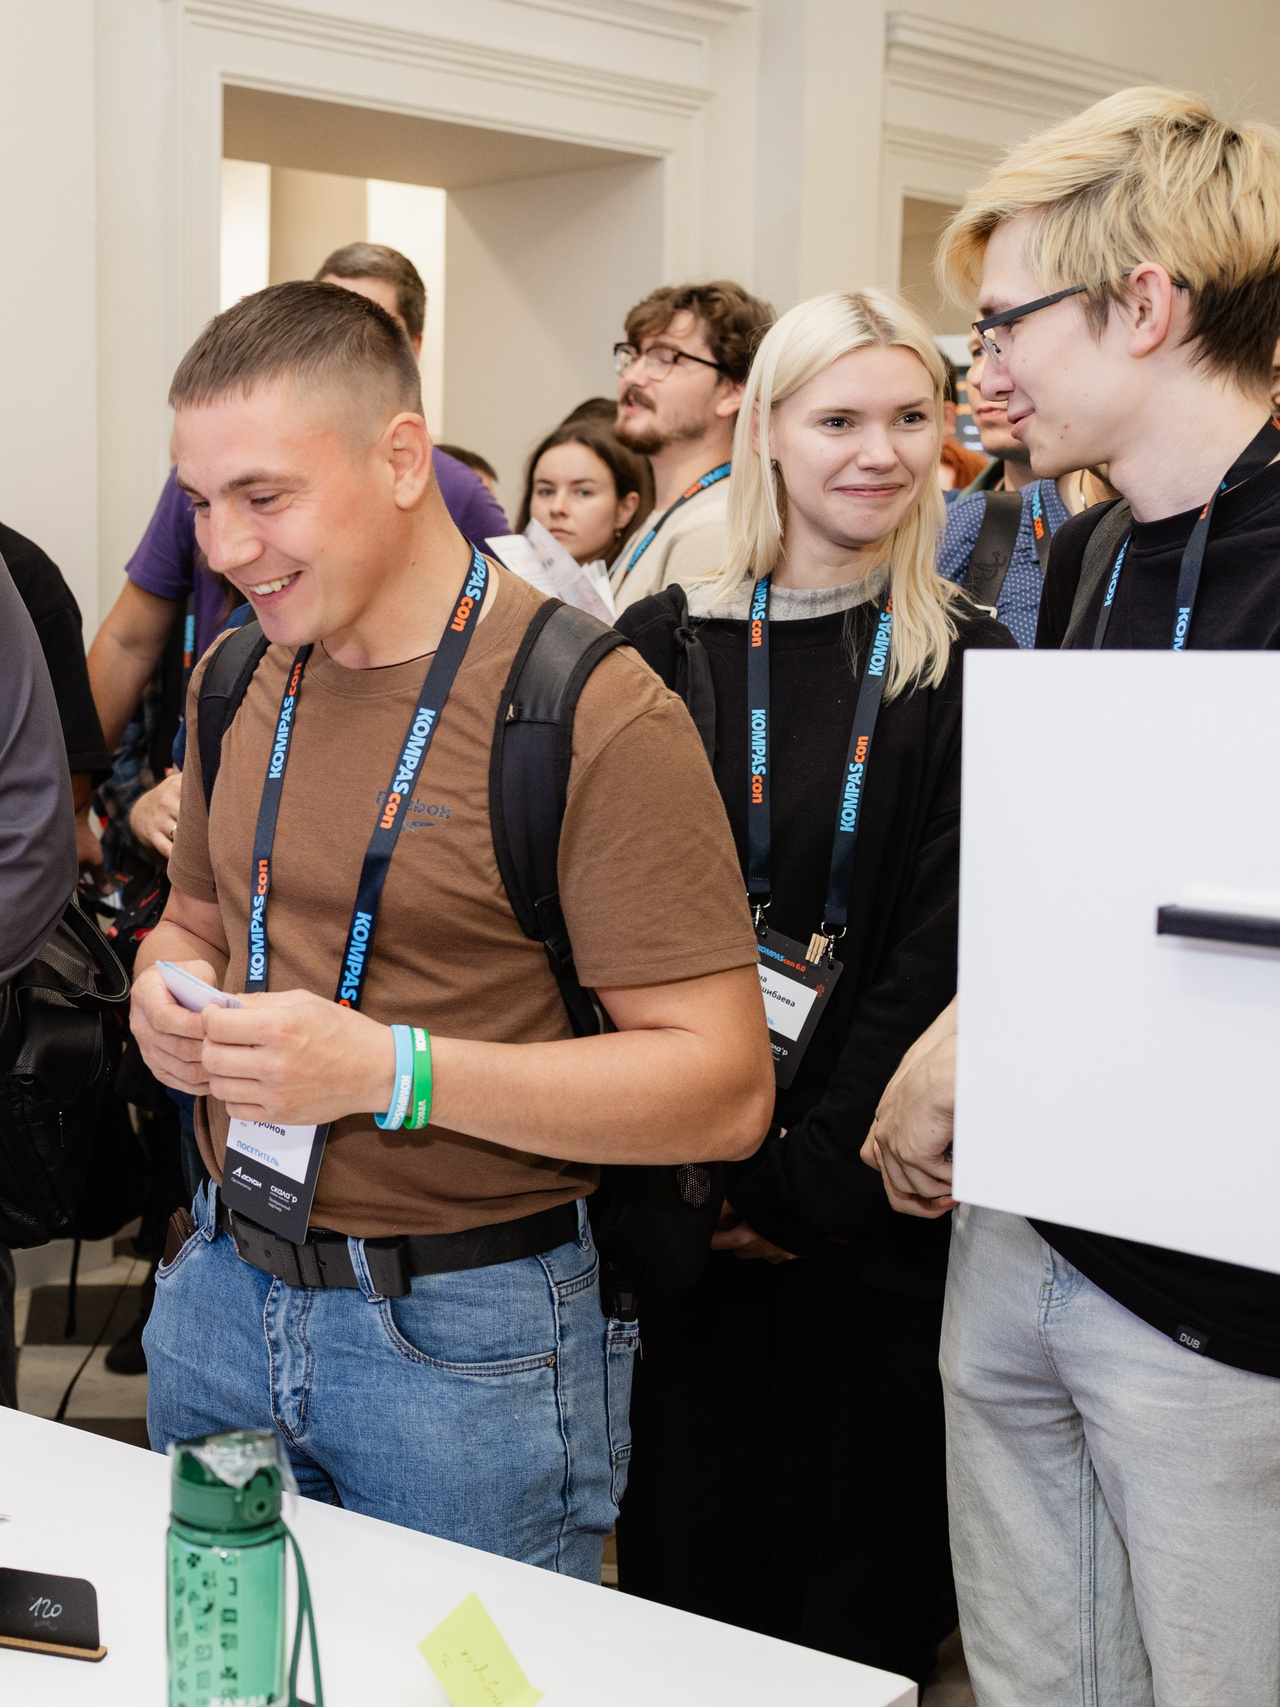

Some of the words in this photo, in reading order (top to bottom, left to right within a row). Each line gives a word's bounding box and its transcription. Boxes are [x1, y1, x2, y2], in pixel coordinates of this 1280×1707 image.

[450, 547, 488, 632] MPAScon
[268, 662, 303, 779] KOMPAScon
[380, 706, 437, 830] KOMPAScon
[749, 708, 768, 805] KOMPAScon
[839, 735, 869, 833] KOMPAScon
[248, 858, 270, 981] KOMPAScon
[236, 1139, 280, 1167] ПОСЕТИТЕЛЬ
[1179, 1332, 1201, 1349] DUB
[28, 1596, 63, 1619] 120
